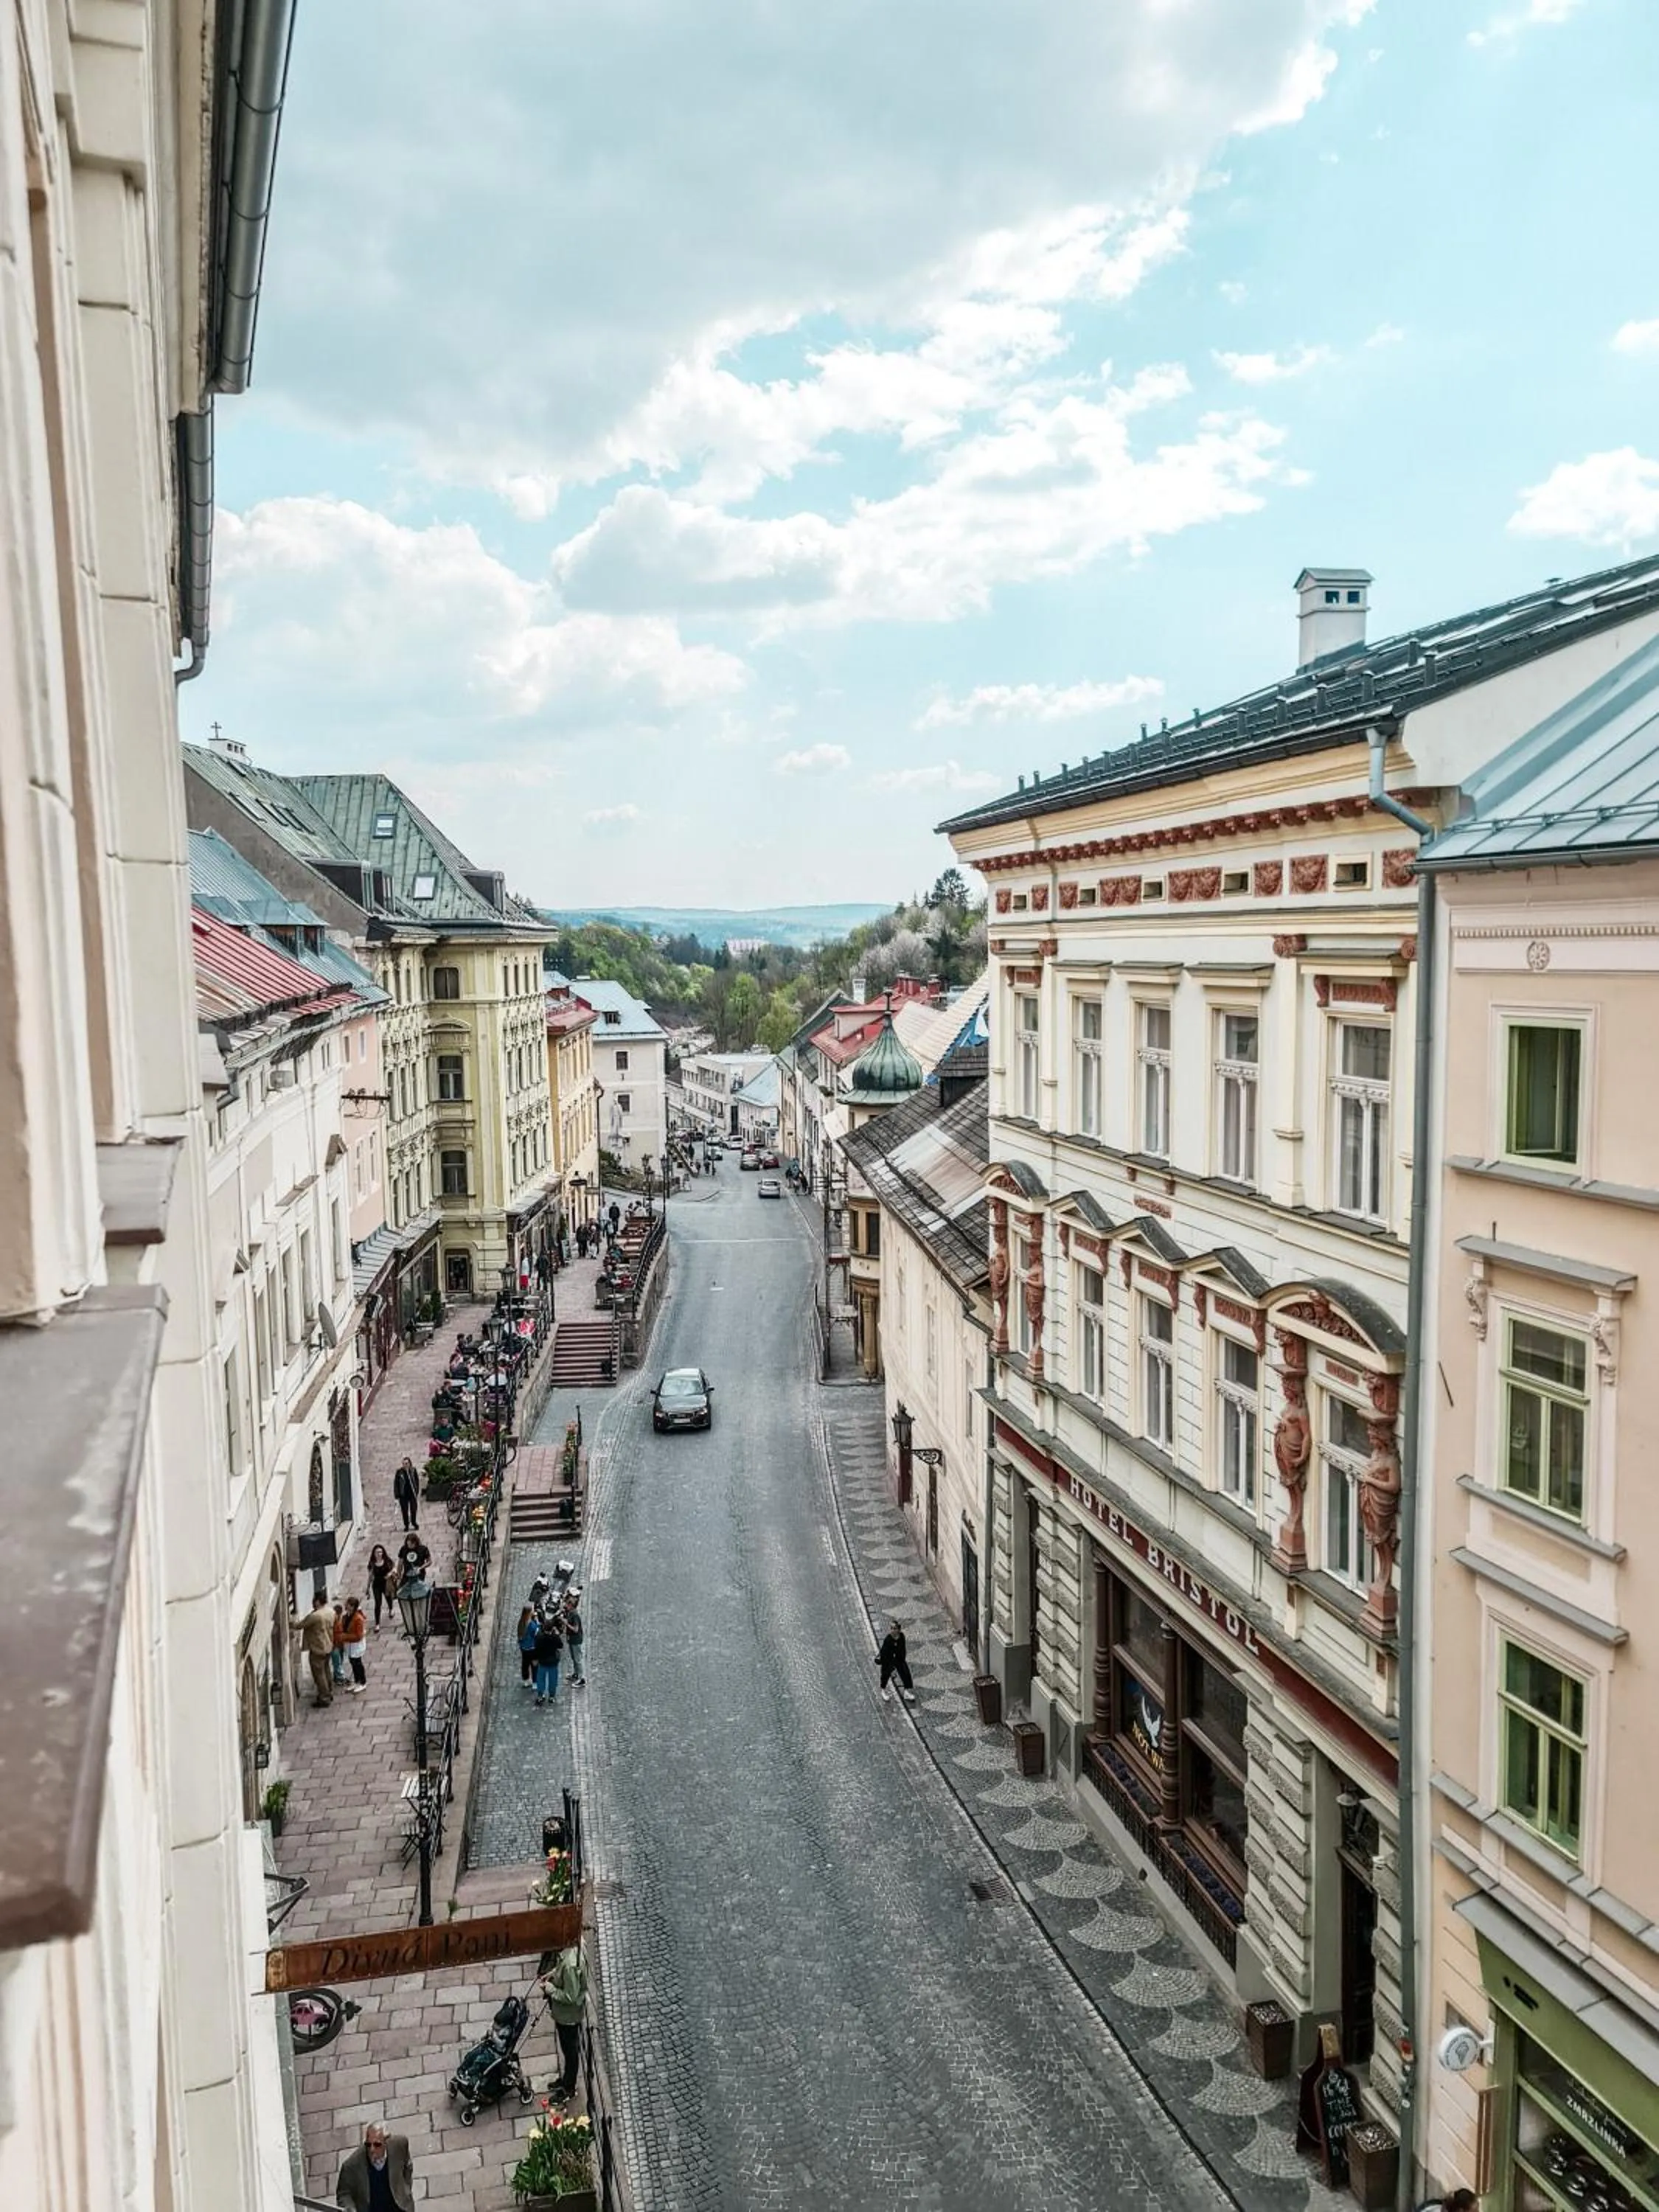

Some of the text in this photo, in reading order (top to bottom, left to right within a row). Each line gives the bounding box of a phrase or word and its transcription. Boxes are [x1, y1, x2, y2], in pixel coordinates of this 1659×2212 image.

[1070, 1476, 1259, 1656] HOTEL BRISTOL
[1151, 1748, 1165, 1770] WA
[321, 1935, 422, 1975] Divná
[1567, 2095, 1626, 2159] ZMRZLINKA
